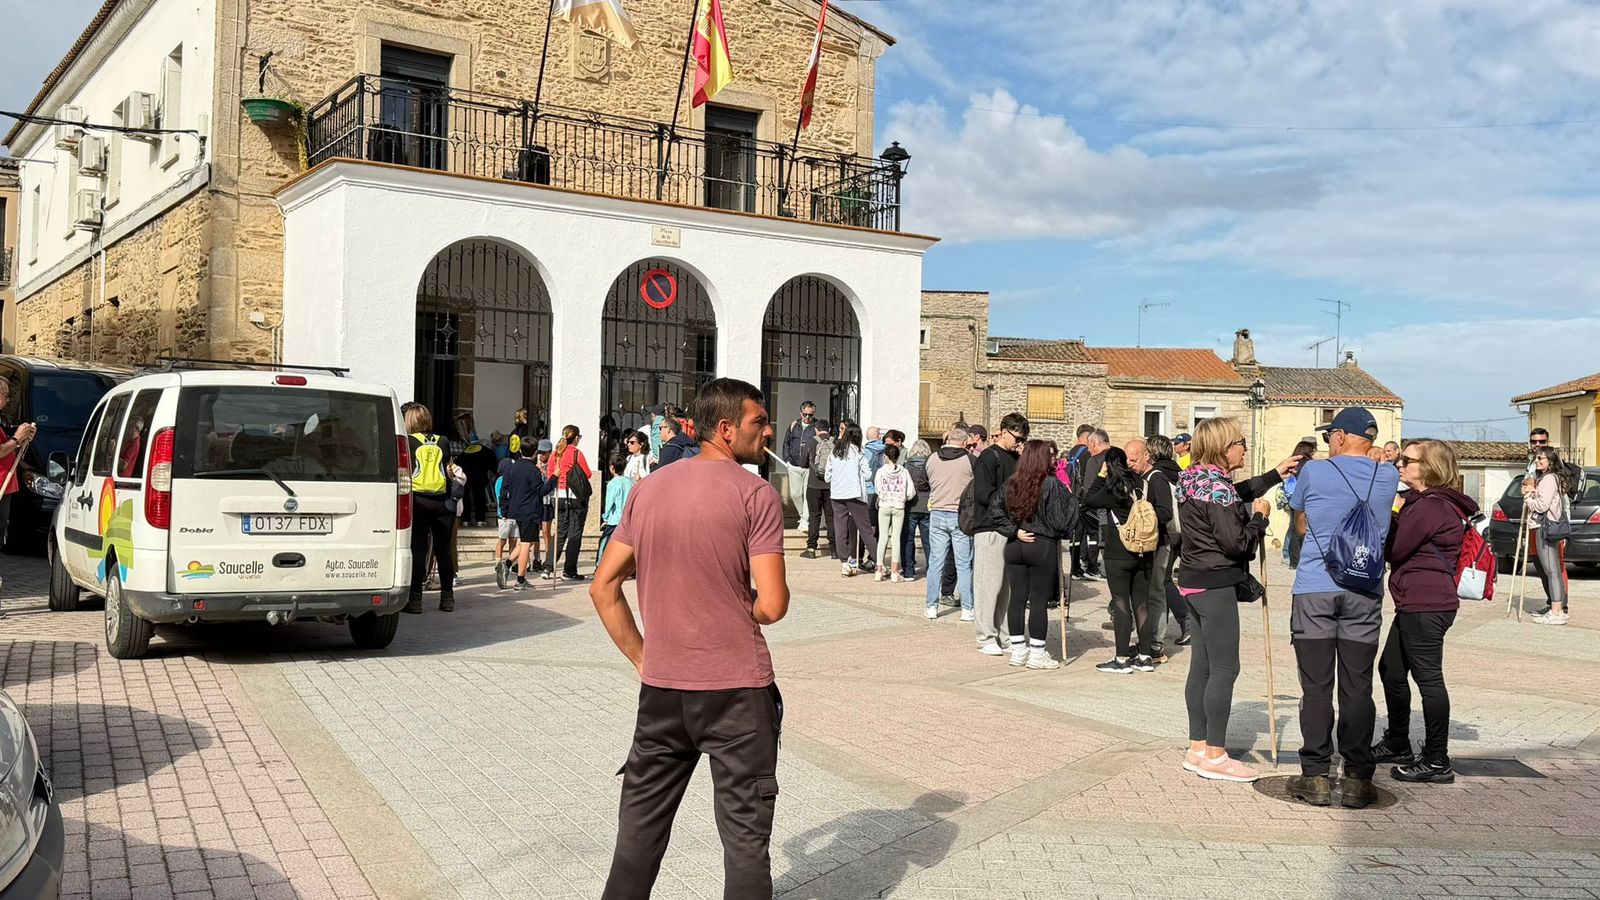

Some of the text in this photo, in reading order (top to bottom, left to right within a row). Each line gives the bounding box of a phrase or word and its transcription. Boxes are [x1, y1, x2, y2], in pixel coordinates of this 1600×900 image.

[255, 516, 326, 530] 0137 FDX
[218, 560, 264, 574] Saucelle
[325, 558, 379, 571] Ayto. Saucelle
[325, 570, 378, 579] www.saucelle.net
